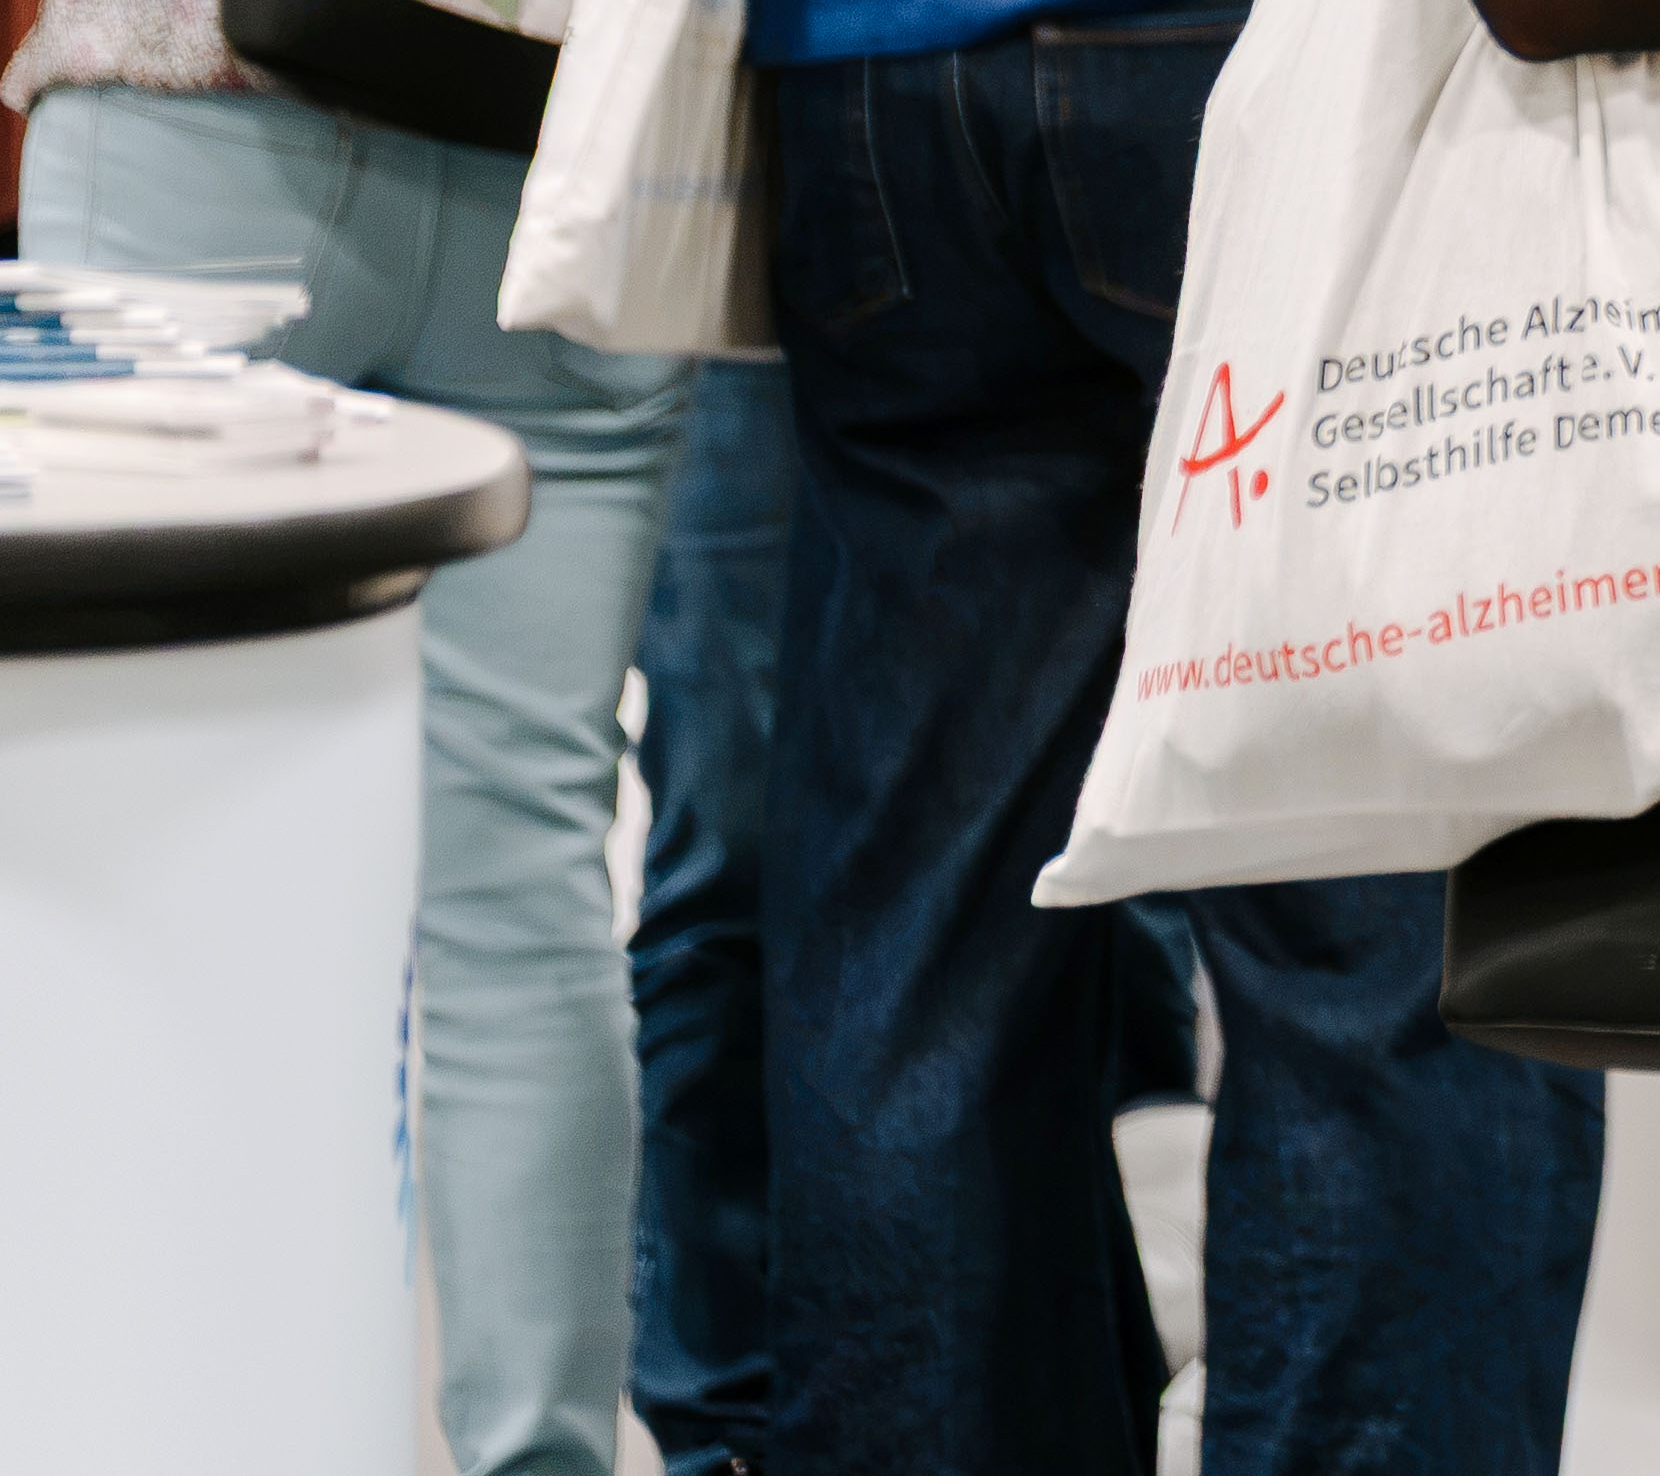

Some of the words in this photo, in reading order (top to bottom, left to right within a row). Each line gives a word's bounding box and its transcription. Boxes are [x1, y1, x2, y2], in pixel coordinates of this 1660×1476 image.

[1312, 354, 1571, 450] Gesellschaft
[1582, 354, 1612, 383] e.
[1617, 344, 1656, 381] V.
[1306, 420, 1537, 509] Selbsthilfe
